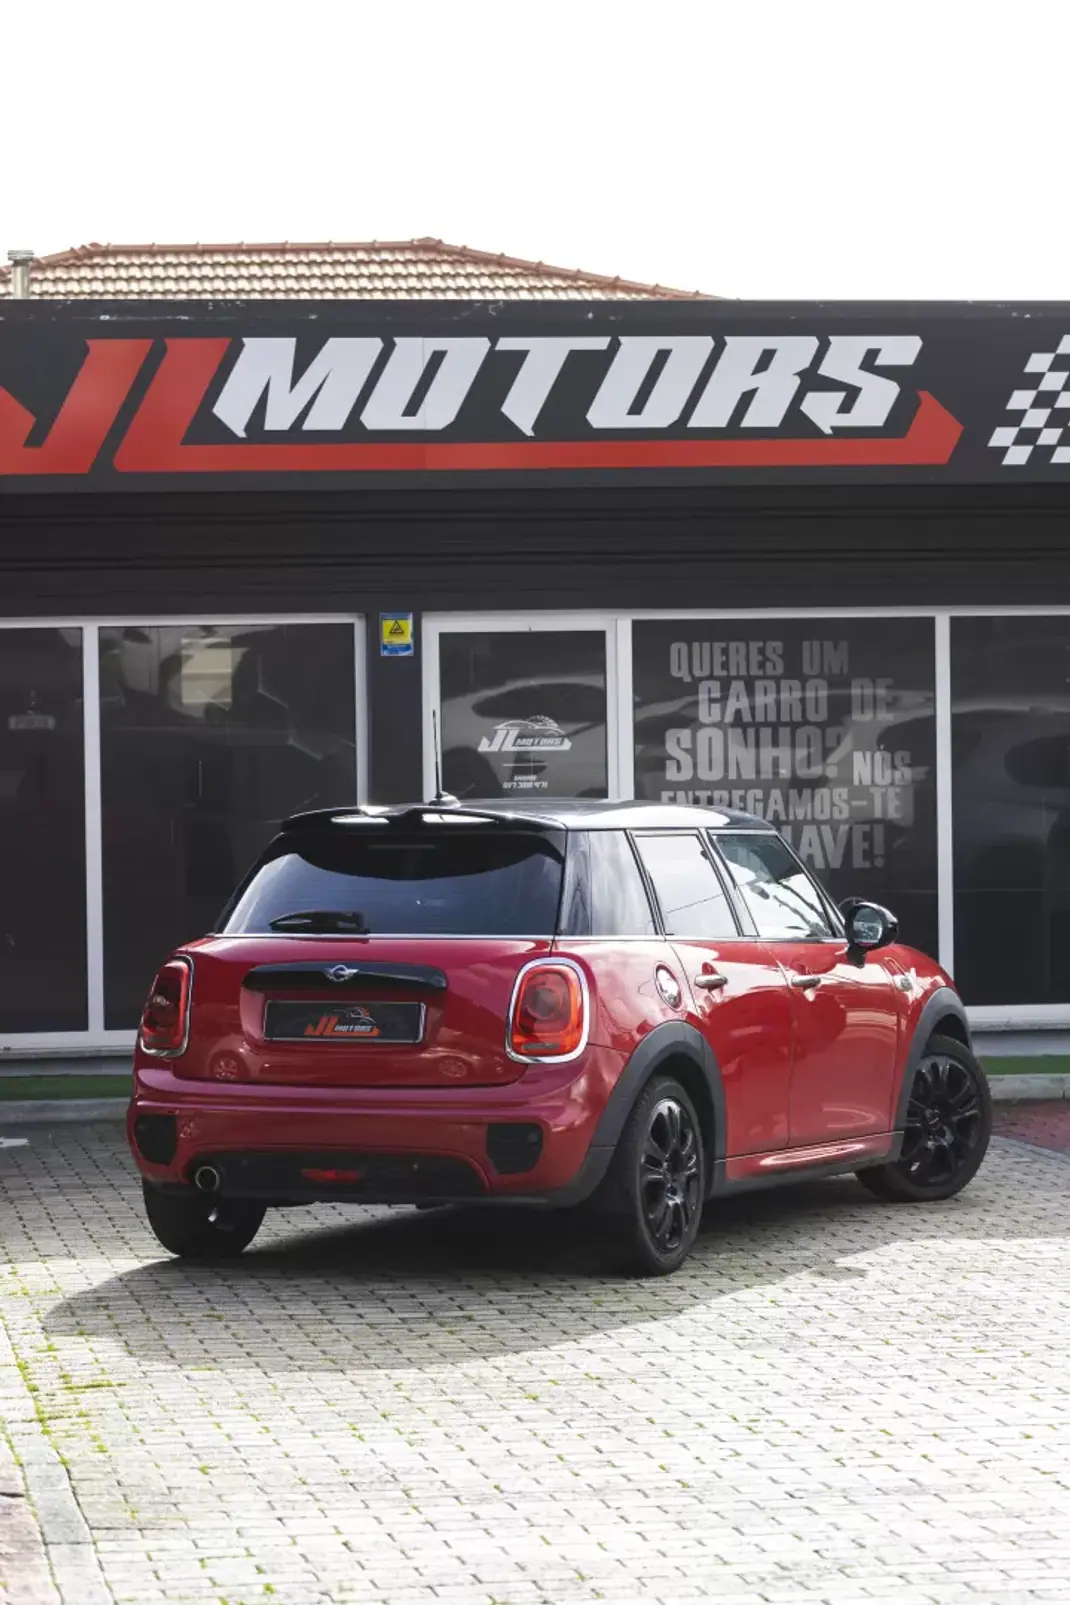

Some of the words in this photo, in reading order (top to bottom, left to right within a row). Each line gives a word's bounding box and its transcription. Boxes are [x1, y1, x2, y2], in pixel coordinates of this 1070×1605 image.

[212, 335, 922, 438] MOTORS
[670, 641, 784, 683] QUERES
[802, 640, 848, 676] UM
[698, 679, 828, 724] CARRO
[851, 677, 894, 721] DE
[665, 725, 852, 781] SONHO?
[853, 744, 912, 786] NÓS
